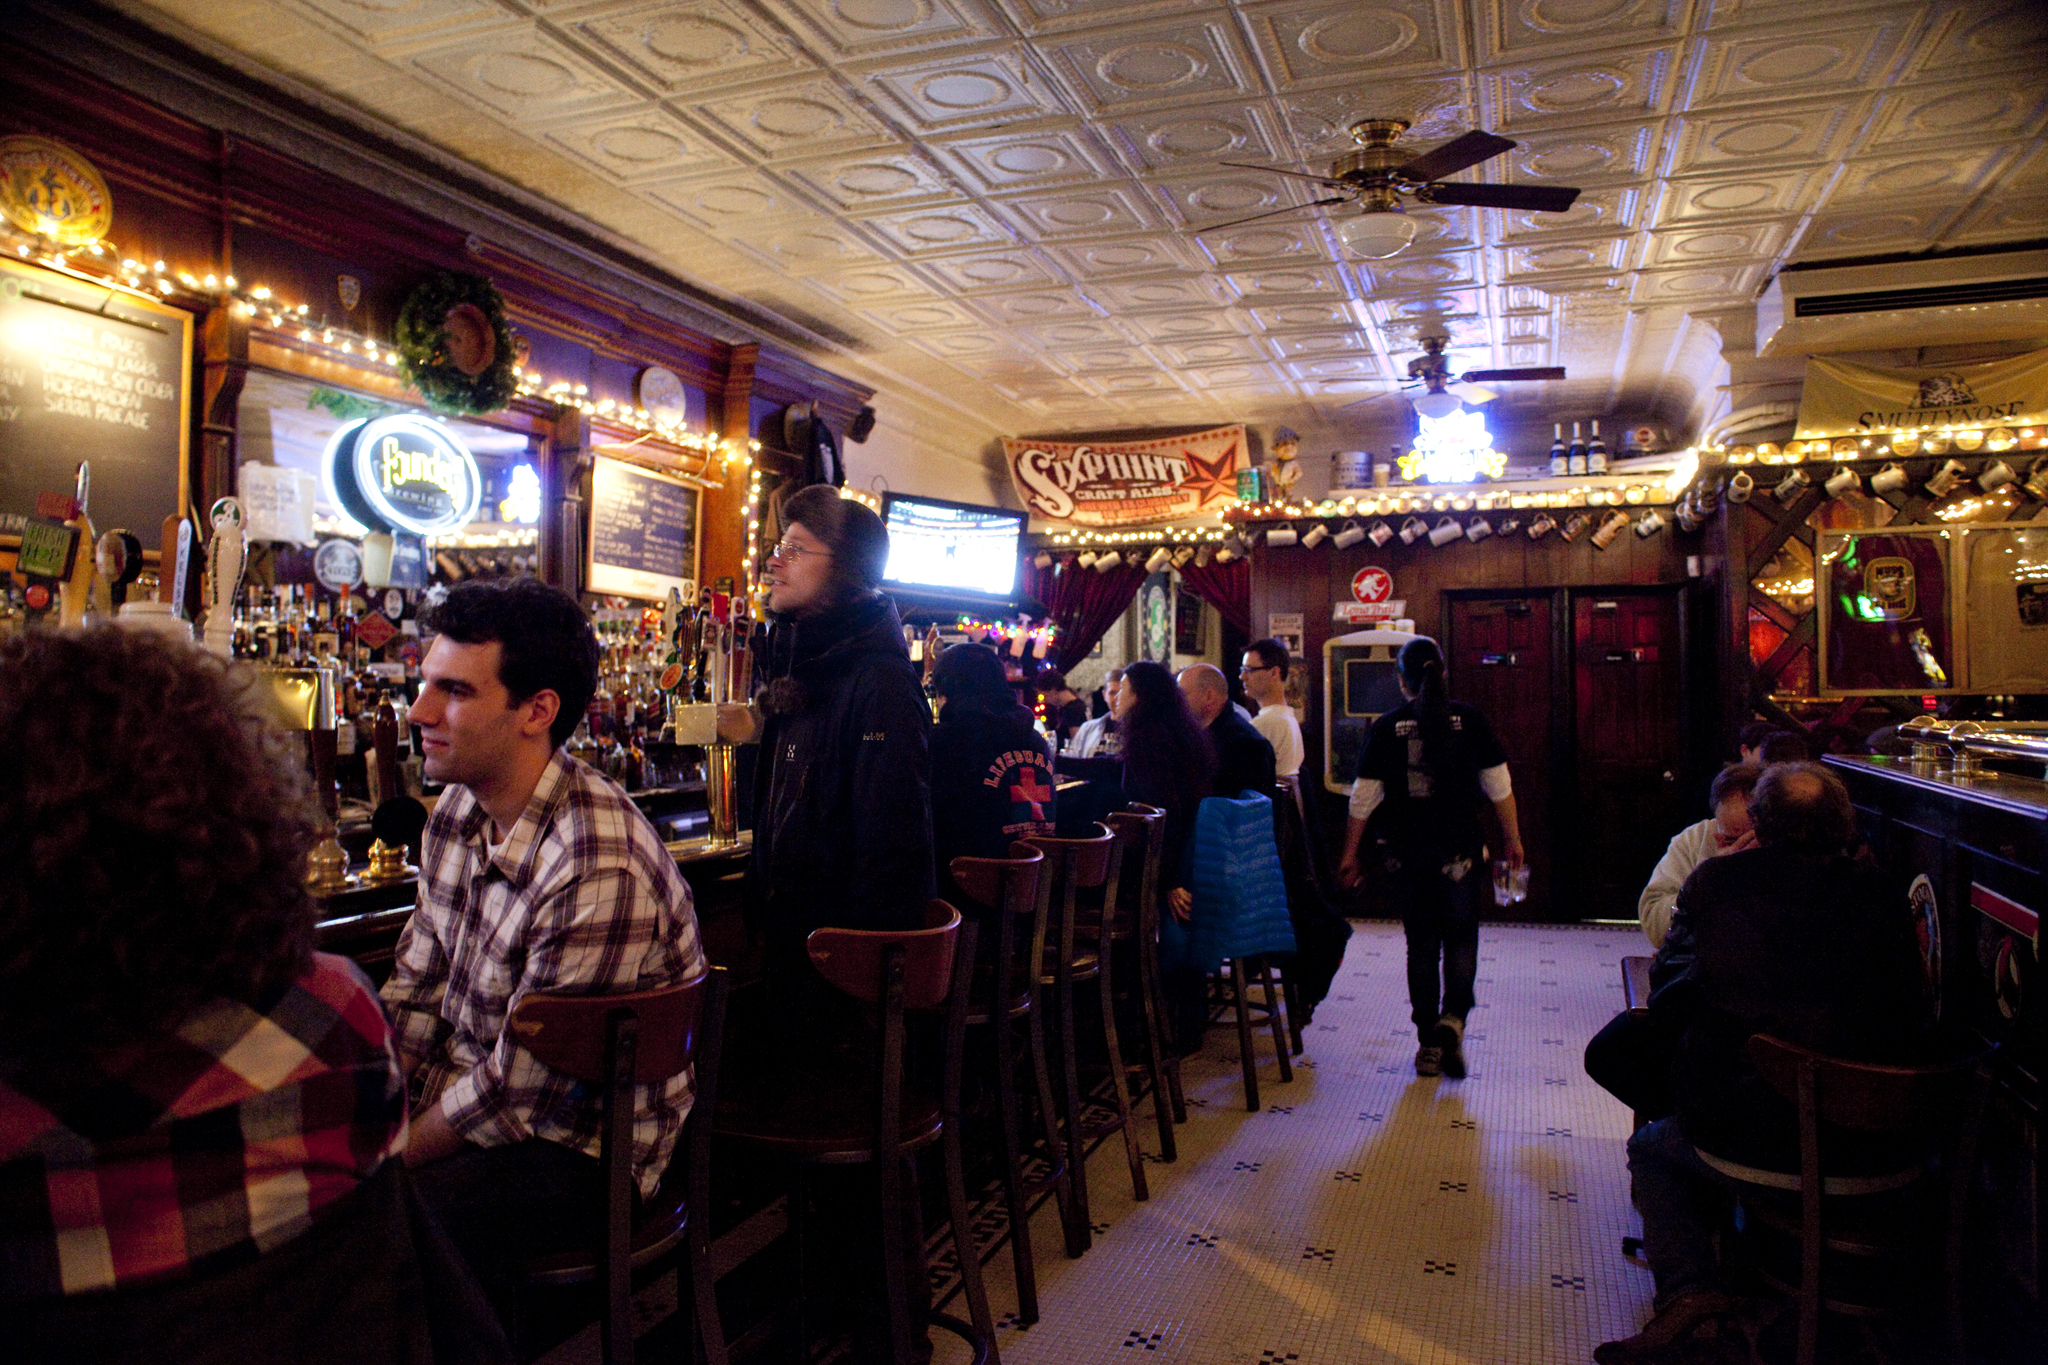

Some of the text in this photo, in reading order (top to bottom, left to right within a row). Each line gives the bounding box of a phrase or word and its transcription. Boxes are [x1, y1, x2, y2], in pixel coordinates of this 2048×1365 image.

[135, 378, 175, 400] CIDER
[1859, 401, 2024, 431] SMUTTYNOSE
[1075, 489, 1126, 500] CRAFT
